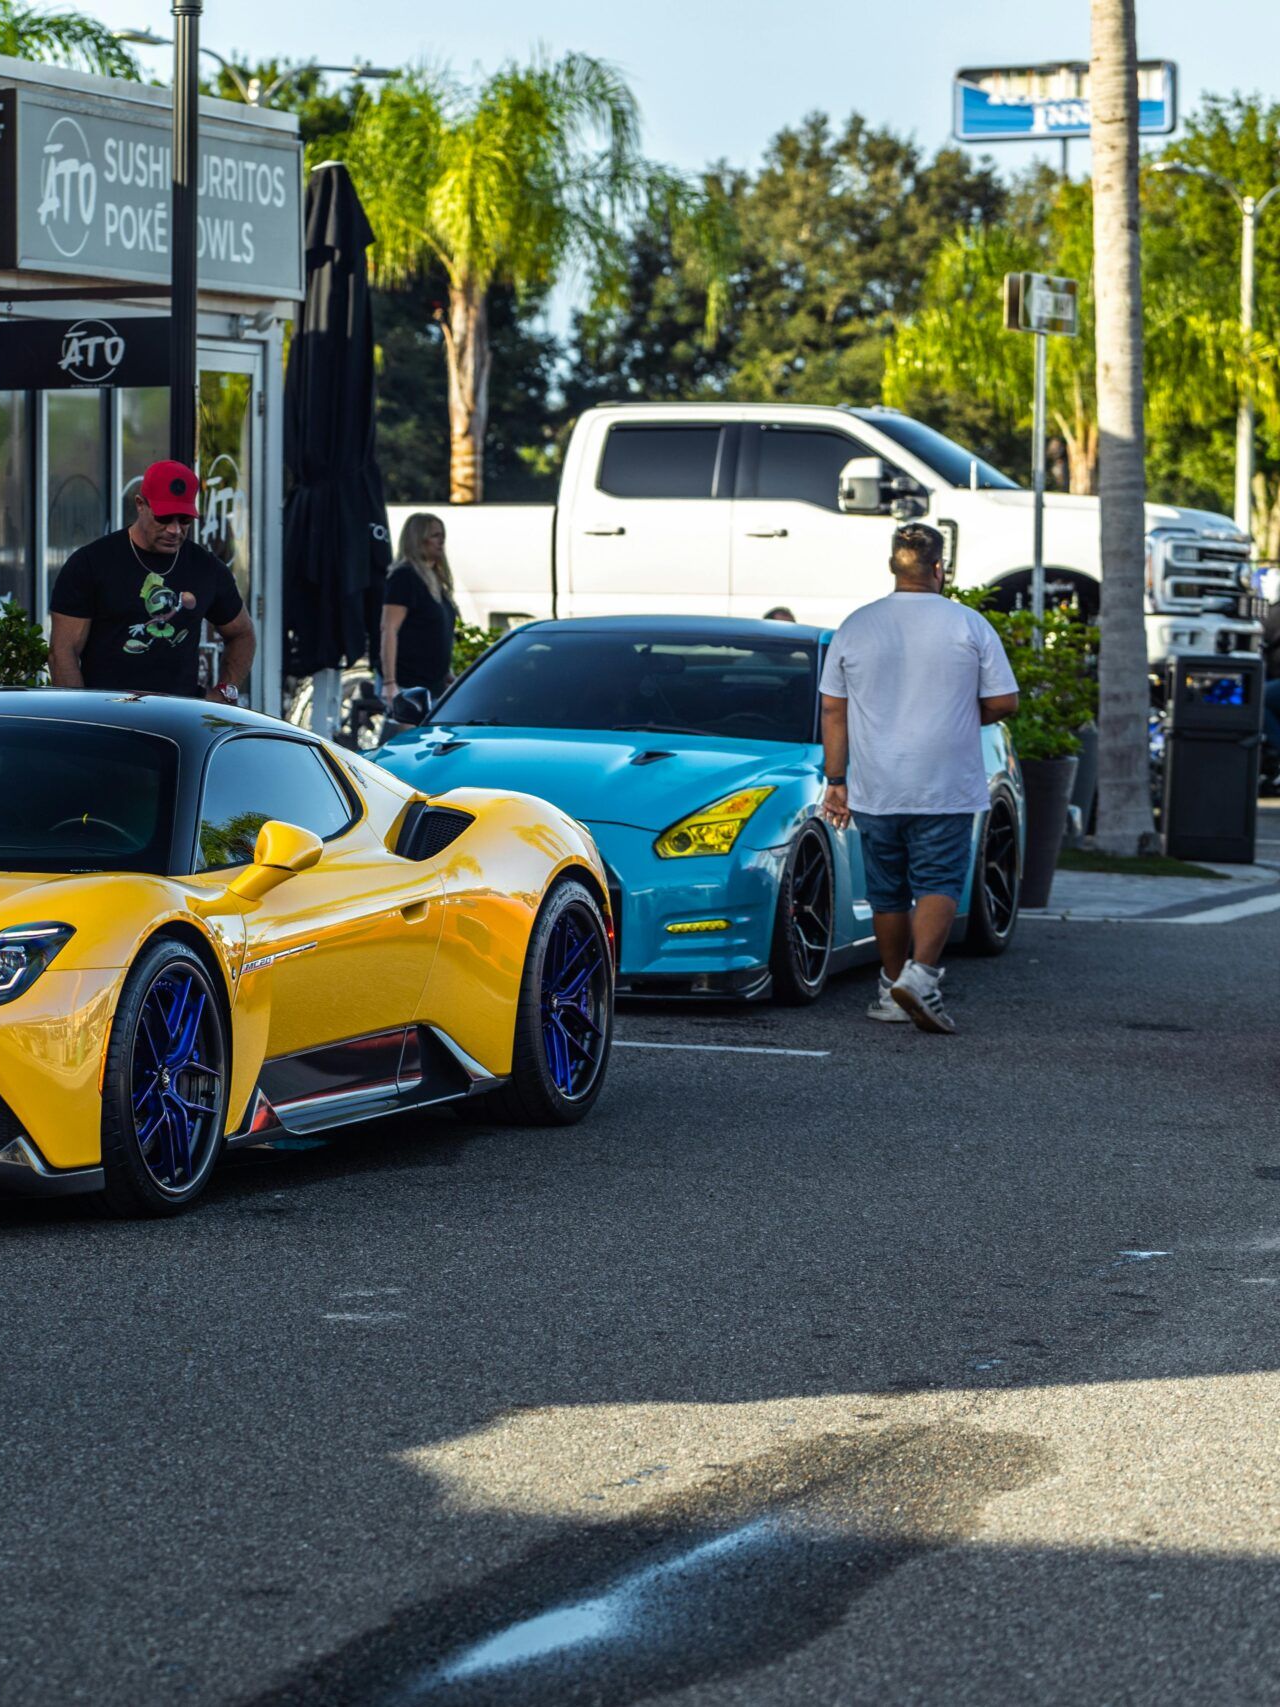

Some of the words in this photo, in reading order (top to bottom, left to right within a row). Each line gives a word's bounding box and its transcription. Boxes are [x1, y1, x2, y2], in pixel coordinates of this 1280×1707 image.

[103, 137, 171, 191] SUSHI
[198, 153, 286, 208] URRITOS
[104, 201, 168, 254] POKÉ
[198, 214, 255, 265] OWLS
